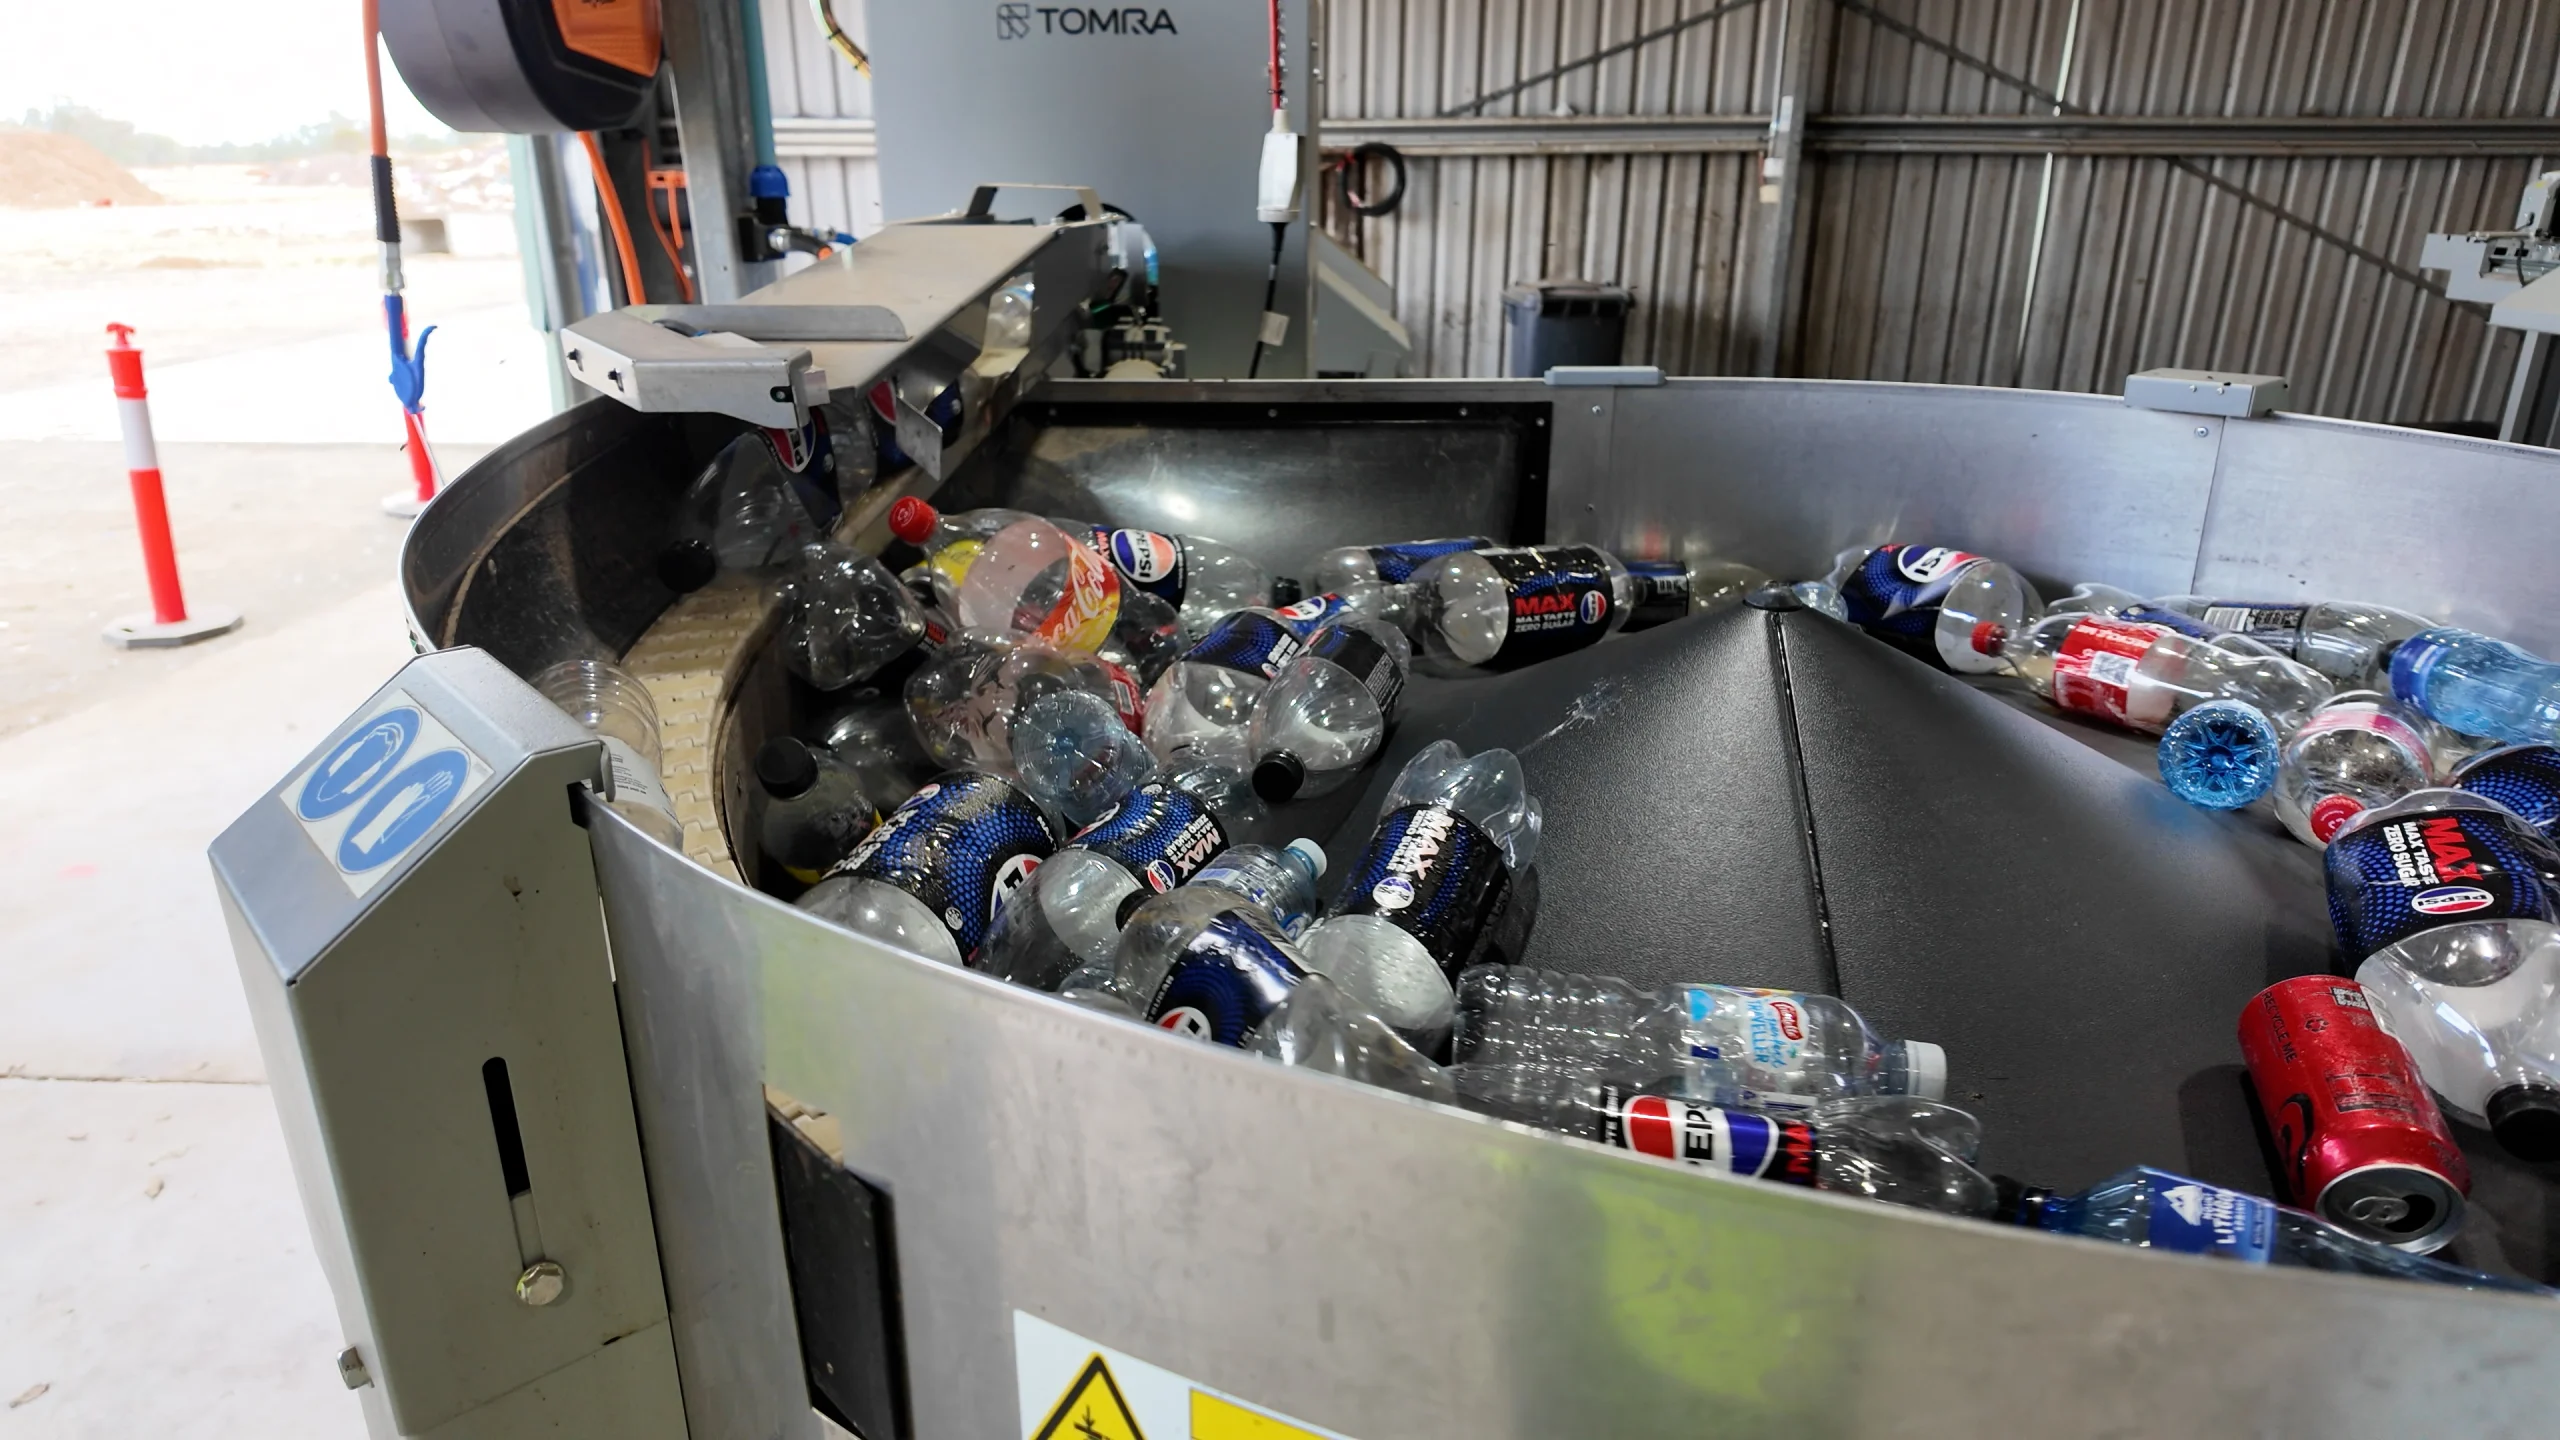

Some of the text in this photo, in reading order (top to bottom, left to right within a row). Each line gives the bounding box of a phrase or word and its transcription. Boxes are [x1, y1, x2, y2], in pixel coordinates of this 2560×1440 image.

[1036, 8, 1178, 35] TOMRA
[1513, 592, 1575, 616] MAX
[1515, 611, 1577, 625] MAX TASTE
[1513, 622, 1542, 633] ZERO
[1163, 813, 1208, 858] ZERO SUGAR
[1171, 820, 1213, 864] MAX TASTE
[1174, 827, 1222, 879] MAX
[2383, 824, 2402, 853] ZERO
[2403, 821, 2440, 885] MAX TASTE
[2423, 817, 2484, 884] MAX
[2417, 894, 2488, 907] PEPSI
[1748, 1000, 1770, 1063] TRAVELLER
[2261, 991, 2298, 1064] RECYCLE ME
